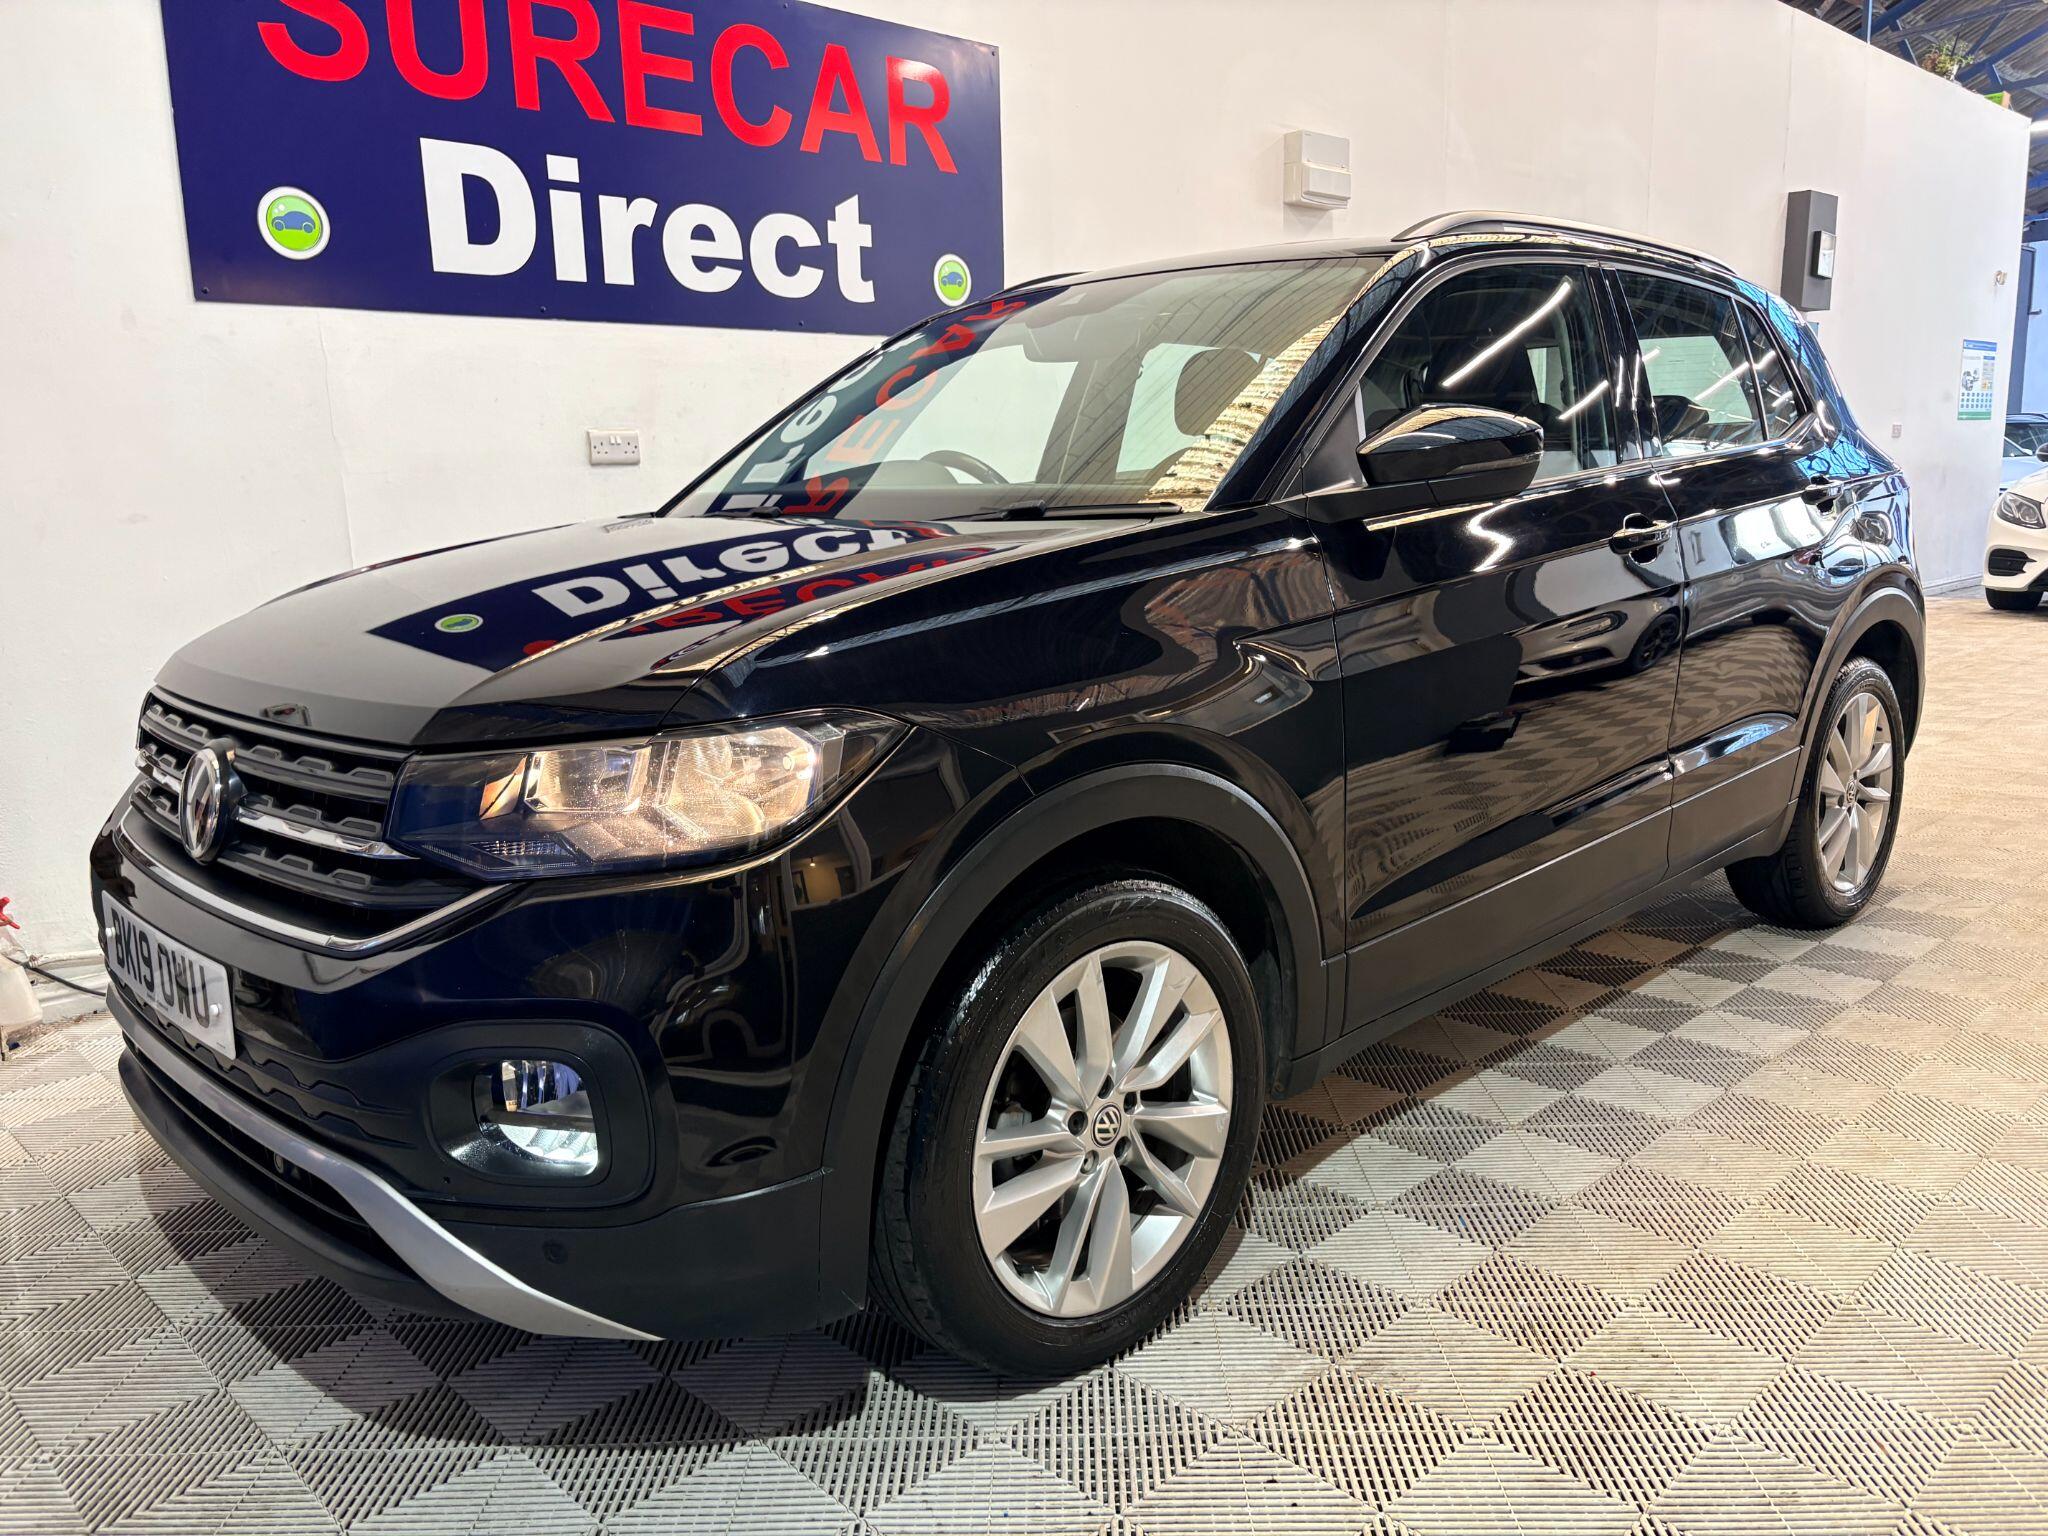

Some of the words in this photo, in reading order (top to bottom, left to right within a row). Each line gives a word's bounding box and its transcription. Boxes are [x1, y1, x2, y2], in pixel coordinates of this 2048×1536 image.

[419, 137, 876, 305] Direct
[111, 906, 155, 993] BK19
[1094, 1105, 1121, 1147] VW
